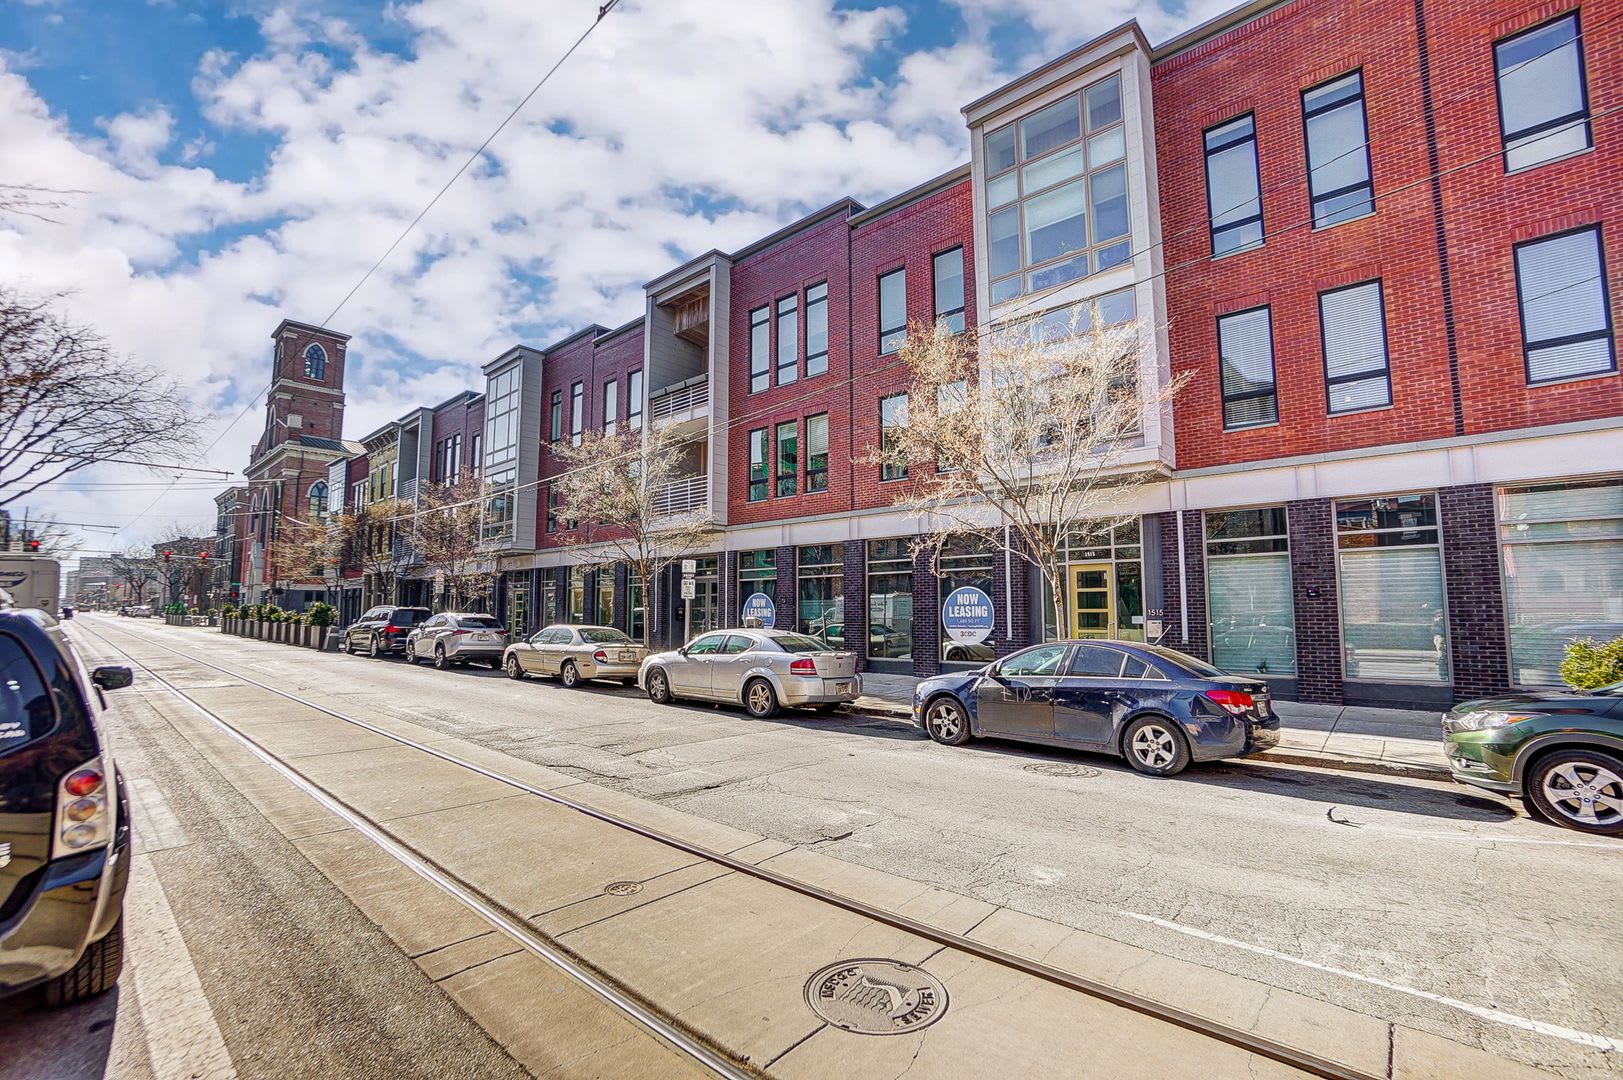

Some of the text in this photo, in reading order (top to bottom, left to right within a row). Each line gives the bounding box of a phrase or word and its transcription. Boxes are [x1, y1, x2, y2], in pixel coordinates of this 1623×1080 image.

[752, 598, 767, 608] NOW
[957, 593, 979, 605] NOW
[747, 608, 772, 617] LEASING
[949, 606, 988, 618] LEASING
[1148, 609, 1164, 617] 1515
